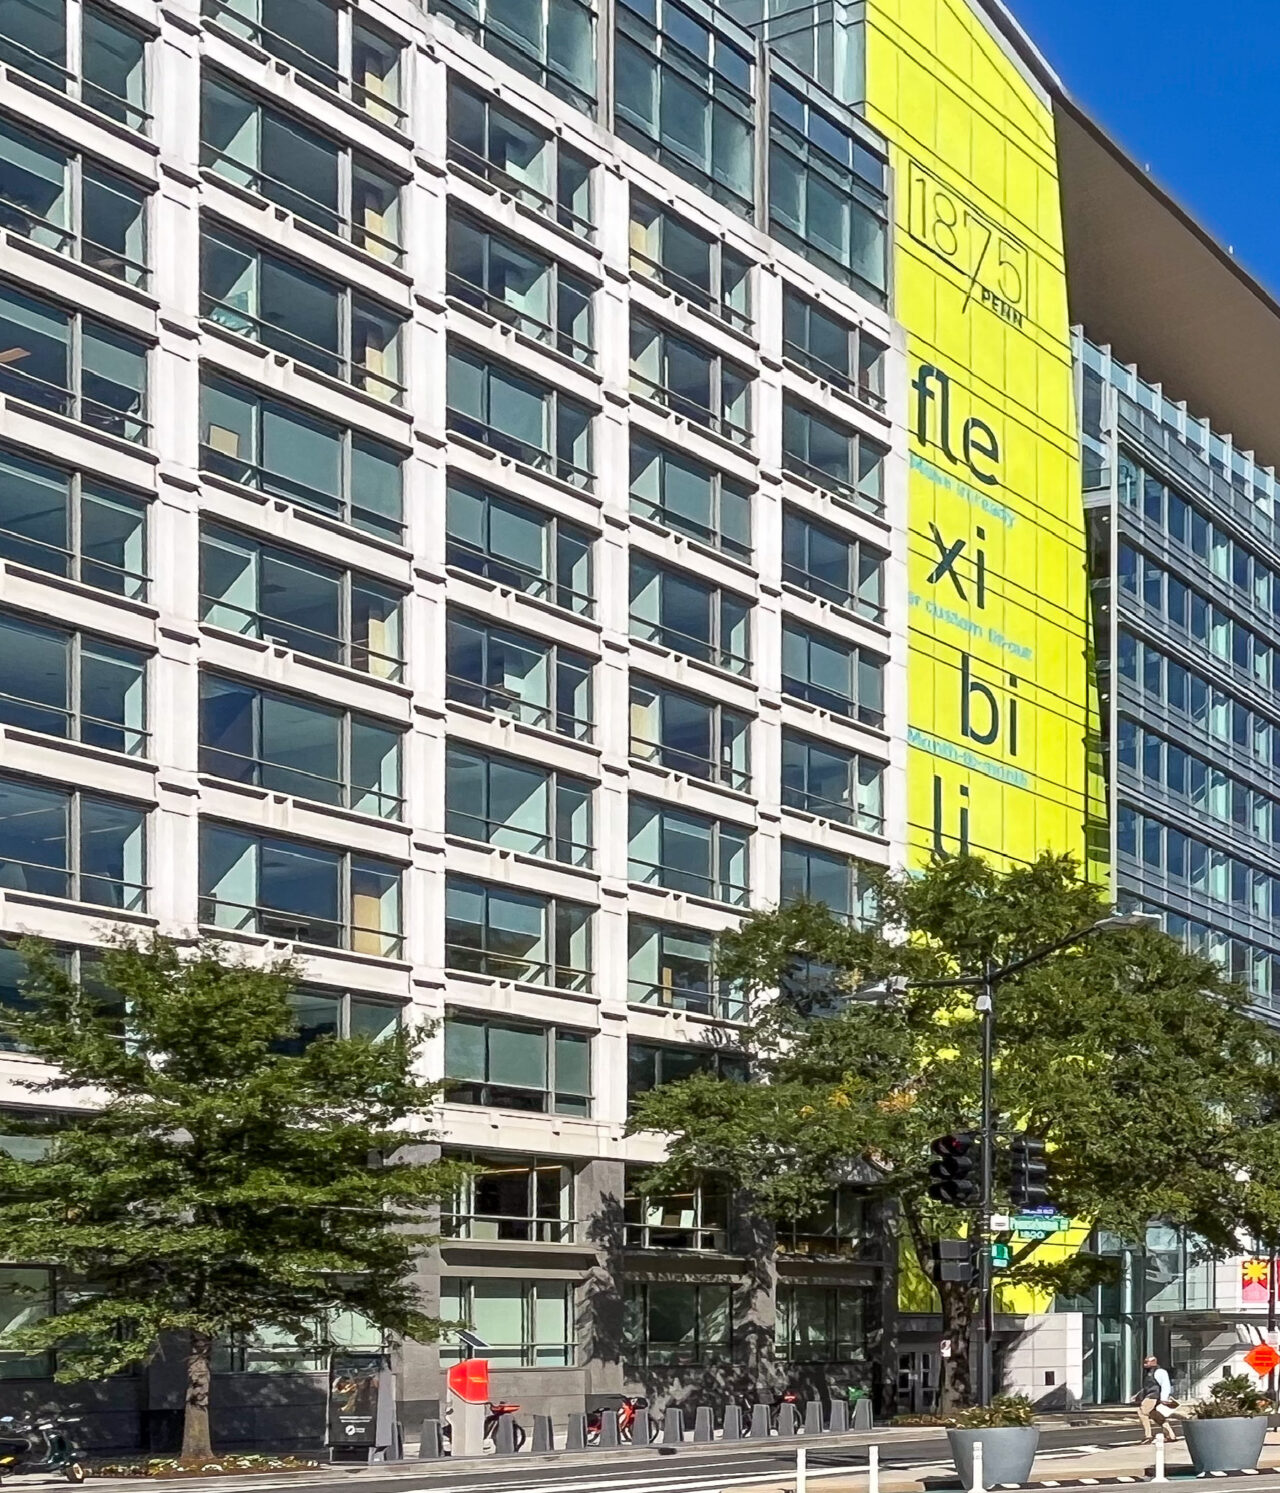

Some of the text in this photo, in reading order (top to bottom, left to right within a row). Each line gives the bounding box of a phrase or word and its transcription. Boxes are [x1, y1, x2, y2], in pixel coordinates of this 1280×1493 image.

[915, 178, 1022, 314] 1875
[981, 285, 1023, 328] PENN
[911, 365, 999, 485] fle
[926, 521, 985, 609] xi
[961, 652, 1017, 757] bi
